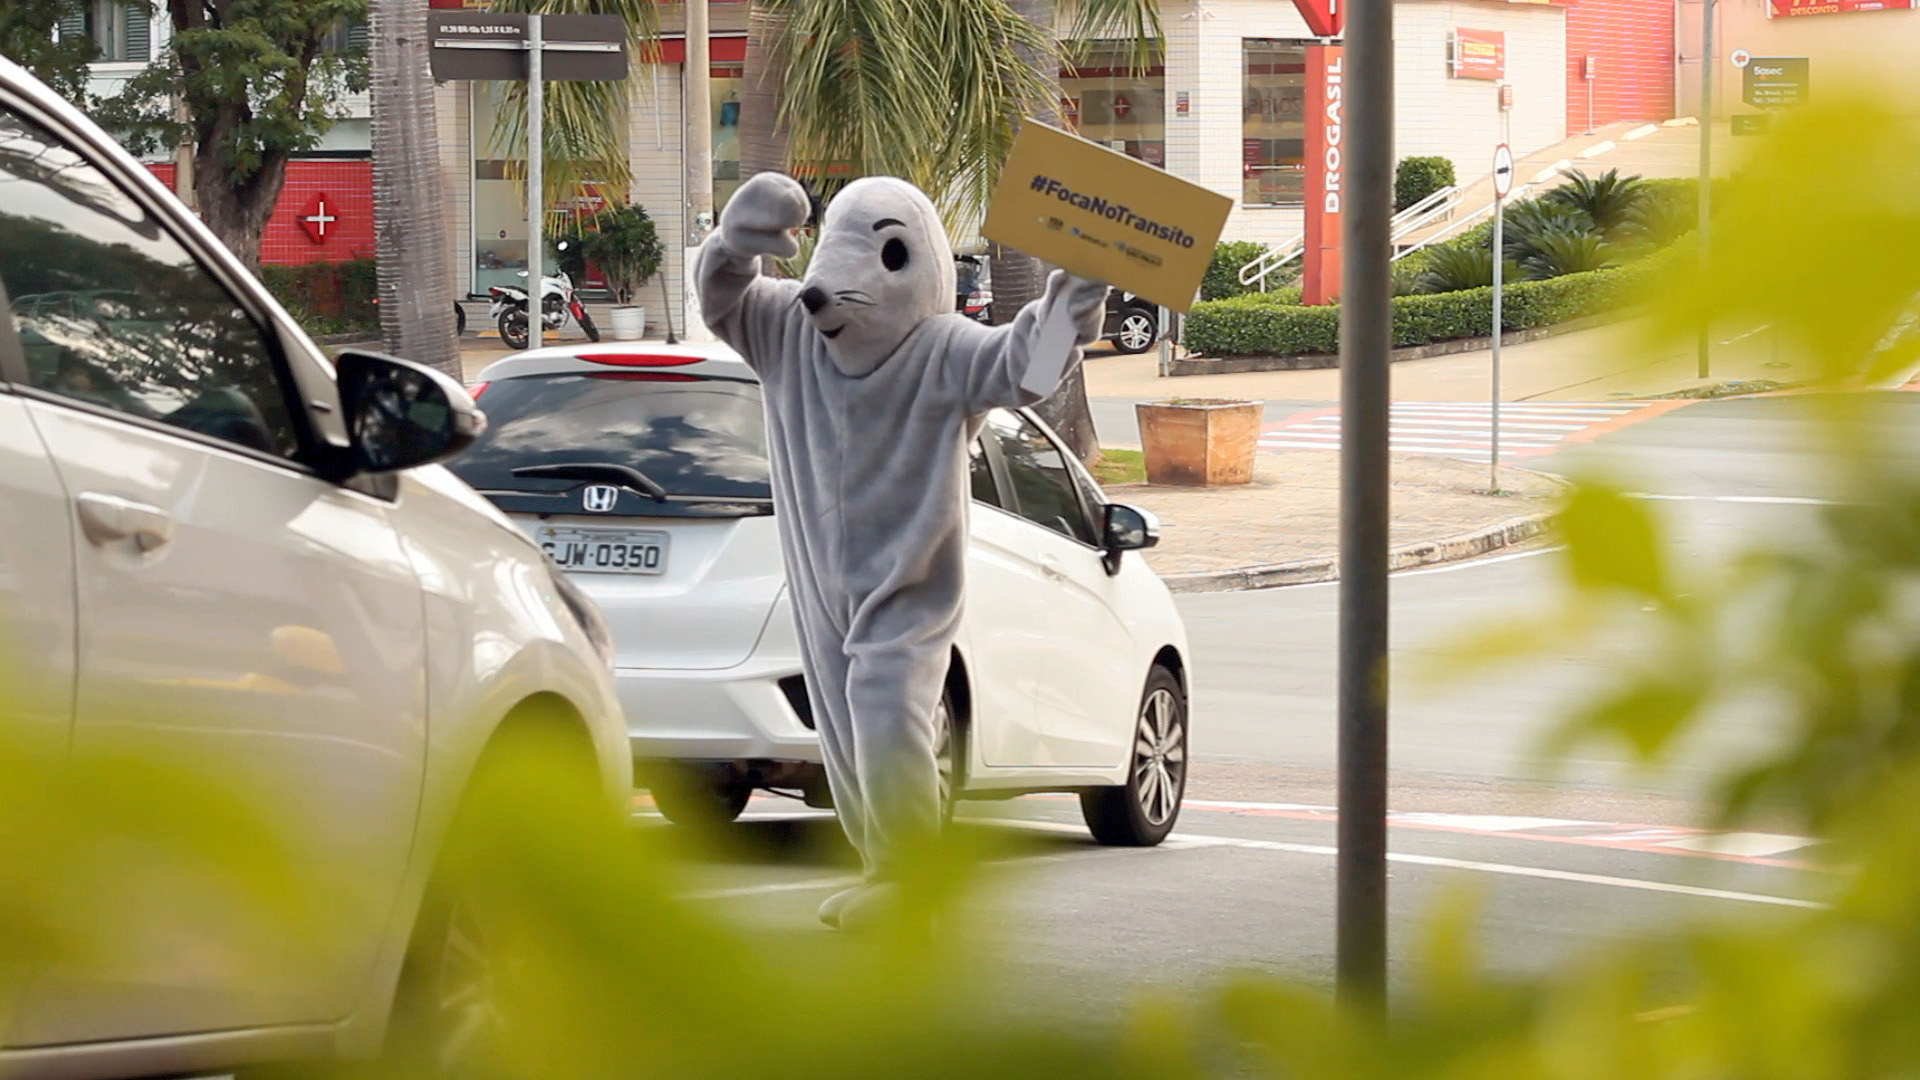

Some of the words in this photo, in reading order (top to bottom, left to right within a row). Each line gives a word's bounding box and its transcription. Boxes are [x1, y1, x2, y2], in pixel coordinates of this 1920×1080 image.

[1789, 5, 1838, 16] DESCONTO
[1325, 57, 1342, 212] DROGASIL
[1030, 174, 1195, 249] #FocaNoTransito
